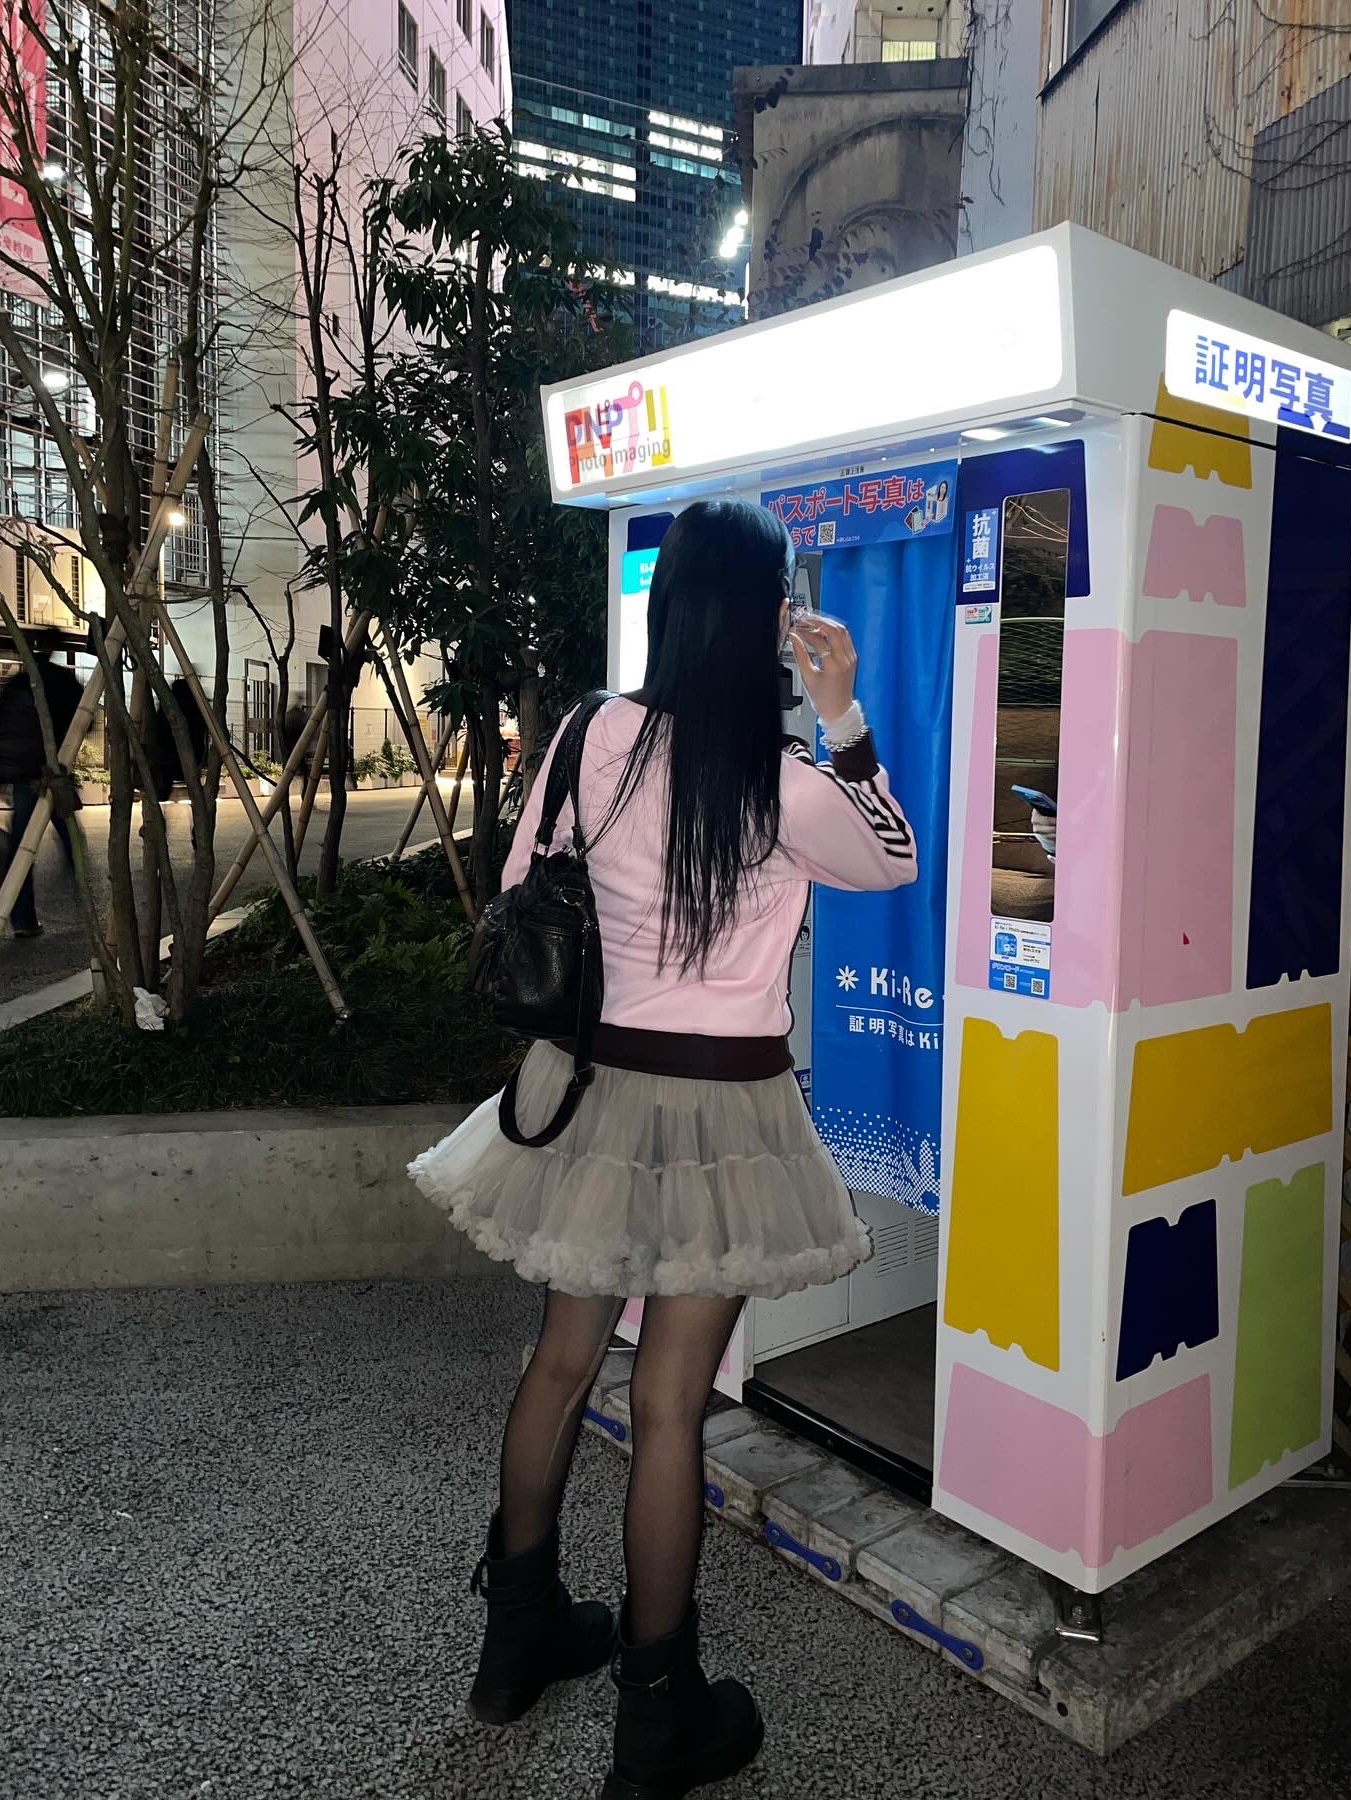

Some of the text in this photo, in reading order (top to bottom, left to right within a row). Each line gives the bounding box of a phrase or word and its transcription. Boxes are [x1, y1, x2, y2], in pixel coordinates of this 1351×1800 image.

[1195, 335, 1334, 422] 証明写真
[768, 475, 925, 523] パスポート写真は
[972, 513, 991, 560] 抗菌
[965, 562, 996, 573] 抗ウイルス
